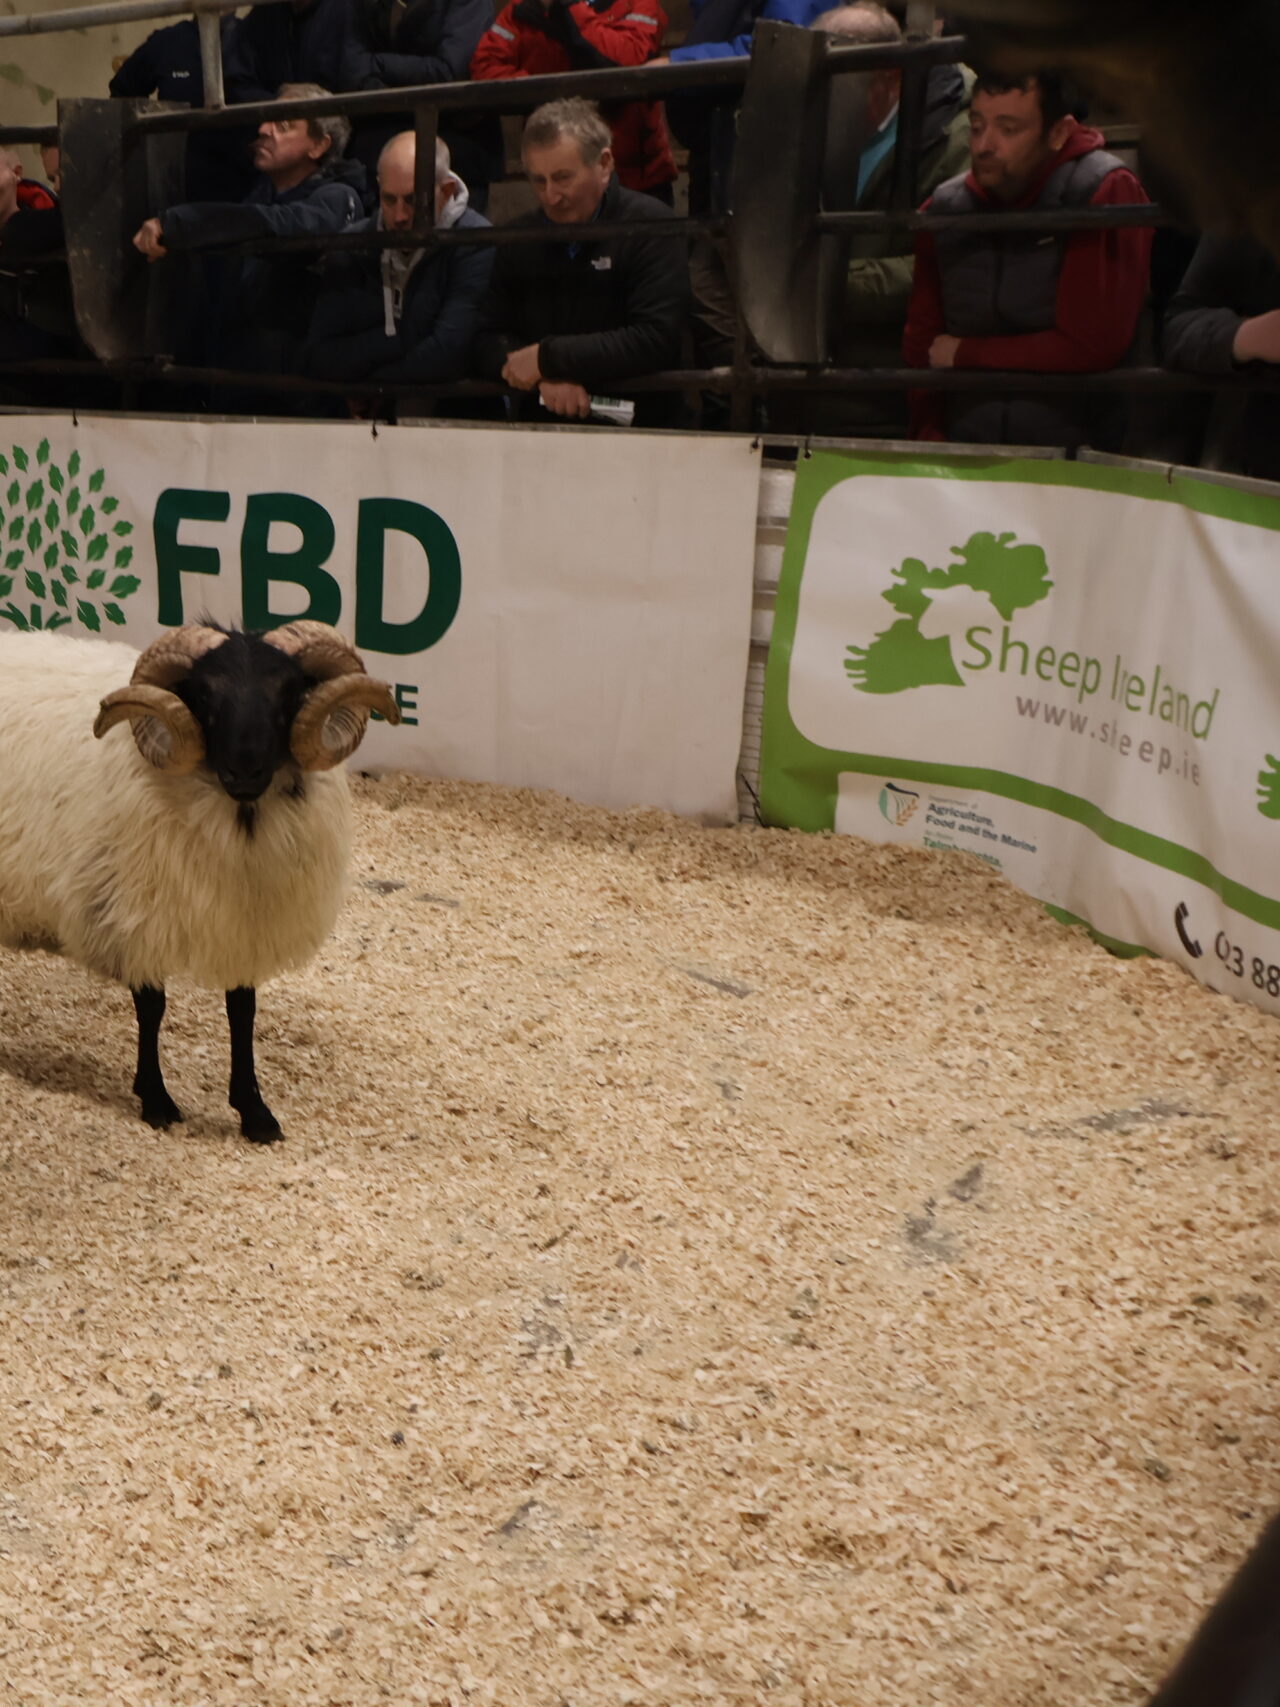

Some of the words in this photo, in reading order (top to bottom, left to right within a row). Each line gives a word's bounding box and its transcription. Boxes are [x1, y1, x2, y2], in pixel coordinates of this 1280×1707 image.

[153, 488, 462, 655] FBD
[961, 624, 1102, 704] Sheep
[958, 823, 981, 836] and
